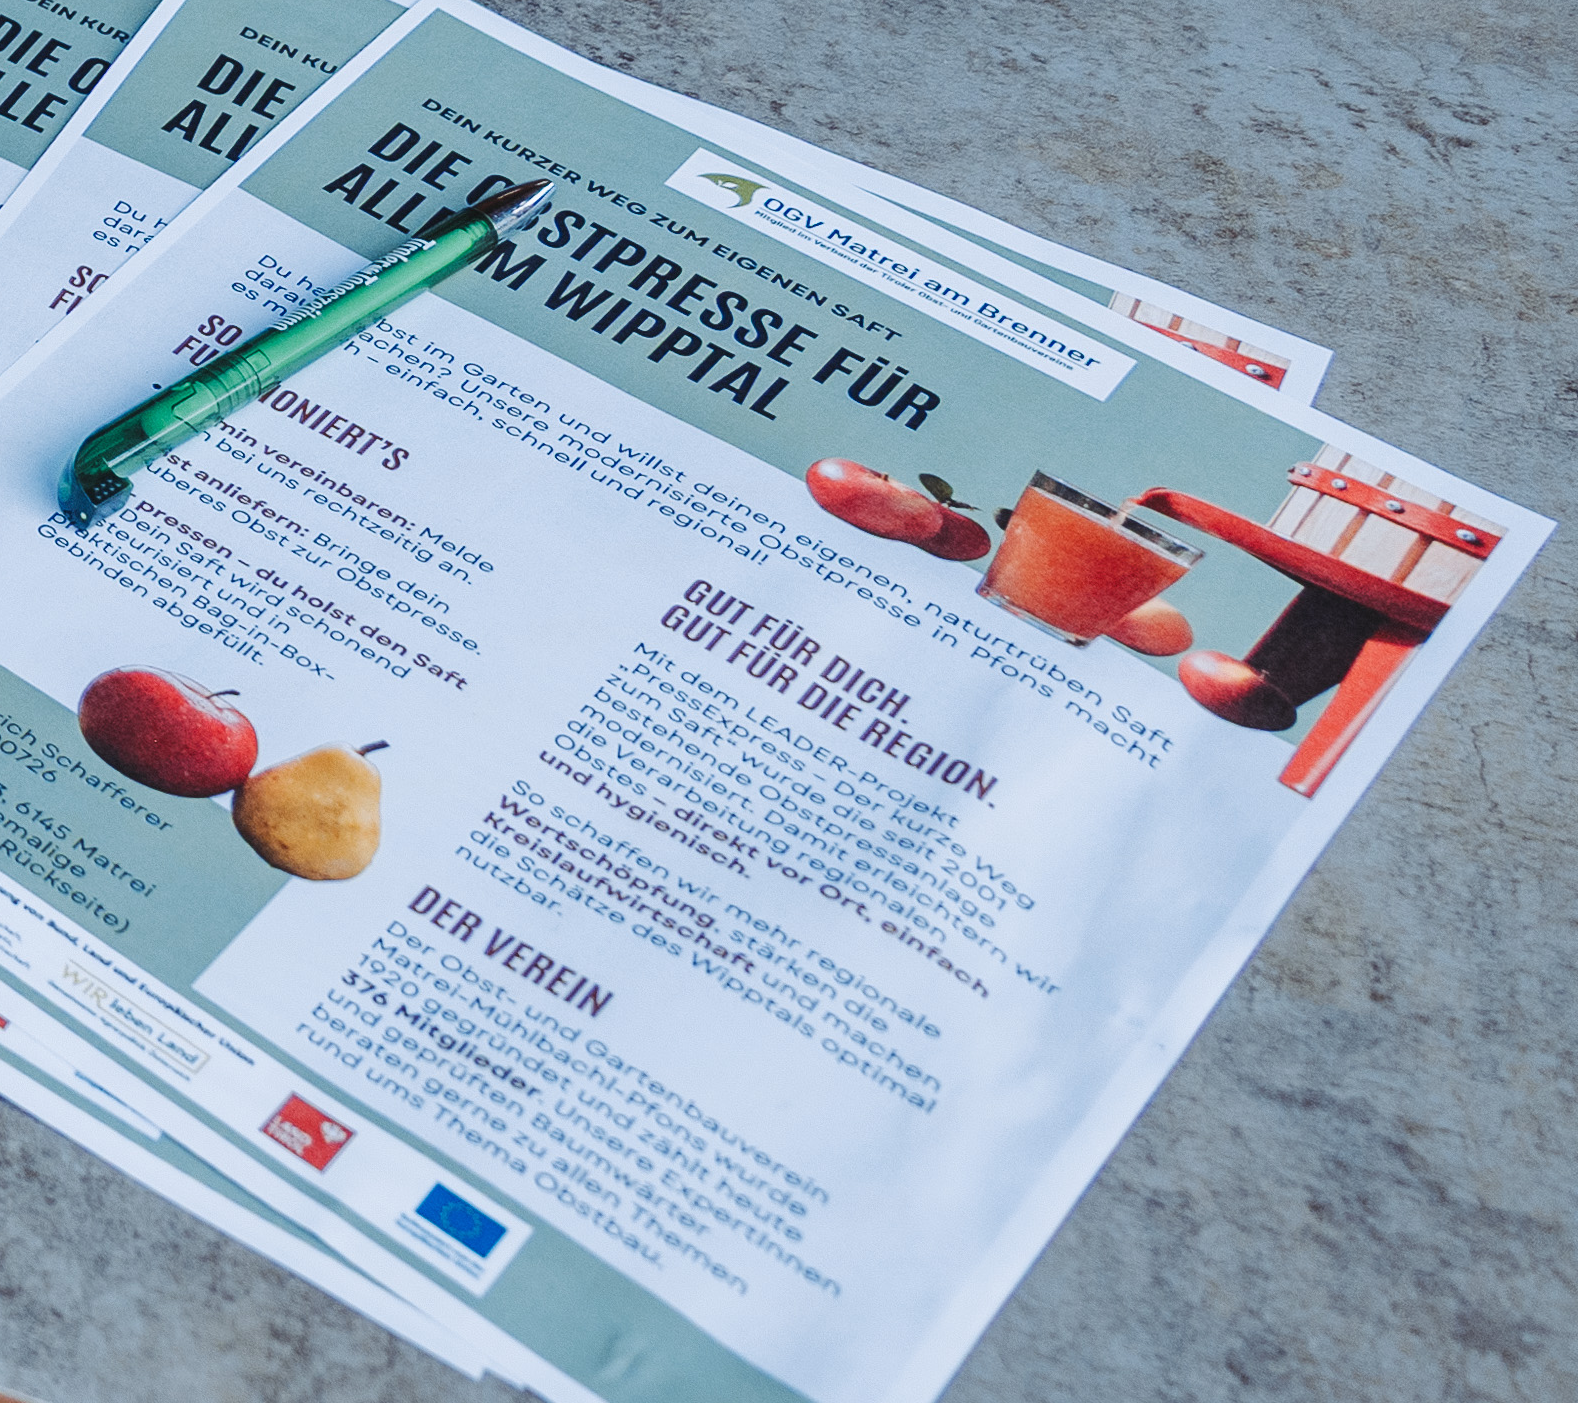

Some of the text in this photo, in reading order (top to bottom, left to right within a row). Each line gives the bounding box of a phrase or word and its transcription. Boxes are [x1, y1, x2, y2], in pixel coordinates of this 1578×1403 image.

[195, 52, 297, 121] DIE
[238, 25, 299, 59] DEIN
[366, 121, 474, 192] DIE
[811, 346, 941, 432] FÜR
[420, 97, 903, 342] DEIN KURZER WEG ZUM EIGENEN SAFT
[762, 197, 1101, 367] OGV Matrei am Brenner
[194, 312, 246, 348] SO
[543, 269, 790, 422] WIPPTAL
[214, 437, 472, 586] bei uns rechtzeitig an.
[262, 443, 494, 573] vereinbaren: Melde
[384, 363, 769, 566] einfach, schnell und regional!
[36, 523, 263, 666] Gebinden abgefüllt.
[117, 507, 412, 679] Dein Saft wird schonend
[133, 499, 468, 691] pressen du holst den Saft
[192, 469, 450, 614] anliefern: Bringe dein
[230, 509, 481, 656] Obst zur Obstpresse.
[421, 340, 1173, 752] im Garten und willst deinen eigenen, naturtrüben Saft
[459, 378, 1160, 769] Unsere modernisierte Obstpresse in Pfons macht
[190, 594, 335, 681] Bag-in-Box-
[659, 603, 999, 809] GUT FÜR DIE REGION.
[682, 578, 912, 725] GUT FÜR DICH.
[40, 742, 173, 831] Schafferer
[618, 662, 1036, 911] „PressExpress Der kurze Weg
[632, 641, 959, 829] Mit dem LEADER-Projekt
[14, 801, 72, 841] 6145
[71, 837, 157, 898] Matrei
[538, 749, 750, 879] und hygienisch.
[553, 733, 989, 999] Obstes direkt vor Ort, einfach
[406, 884, 614, 1018] DER VEREIN
